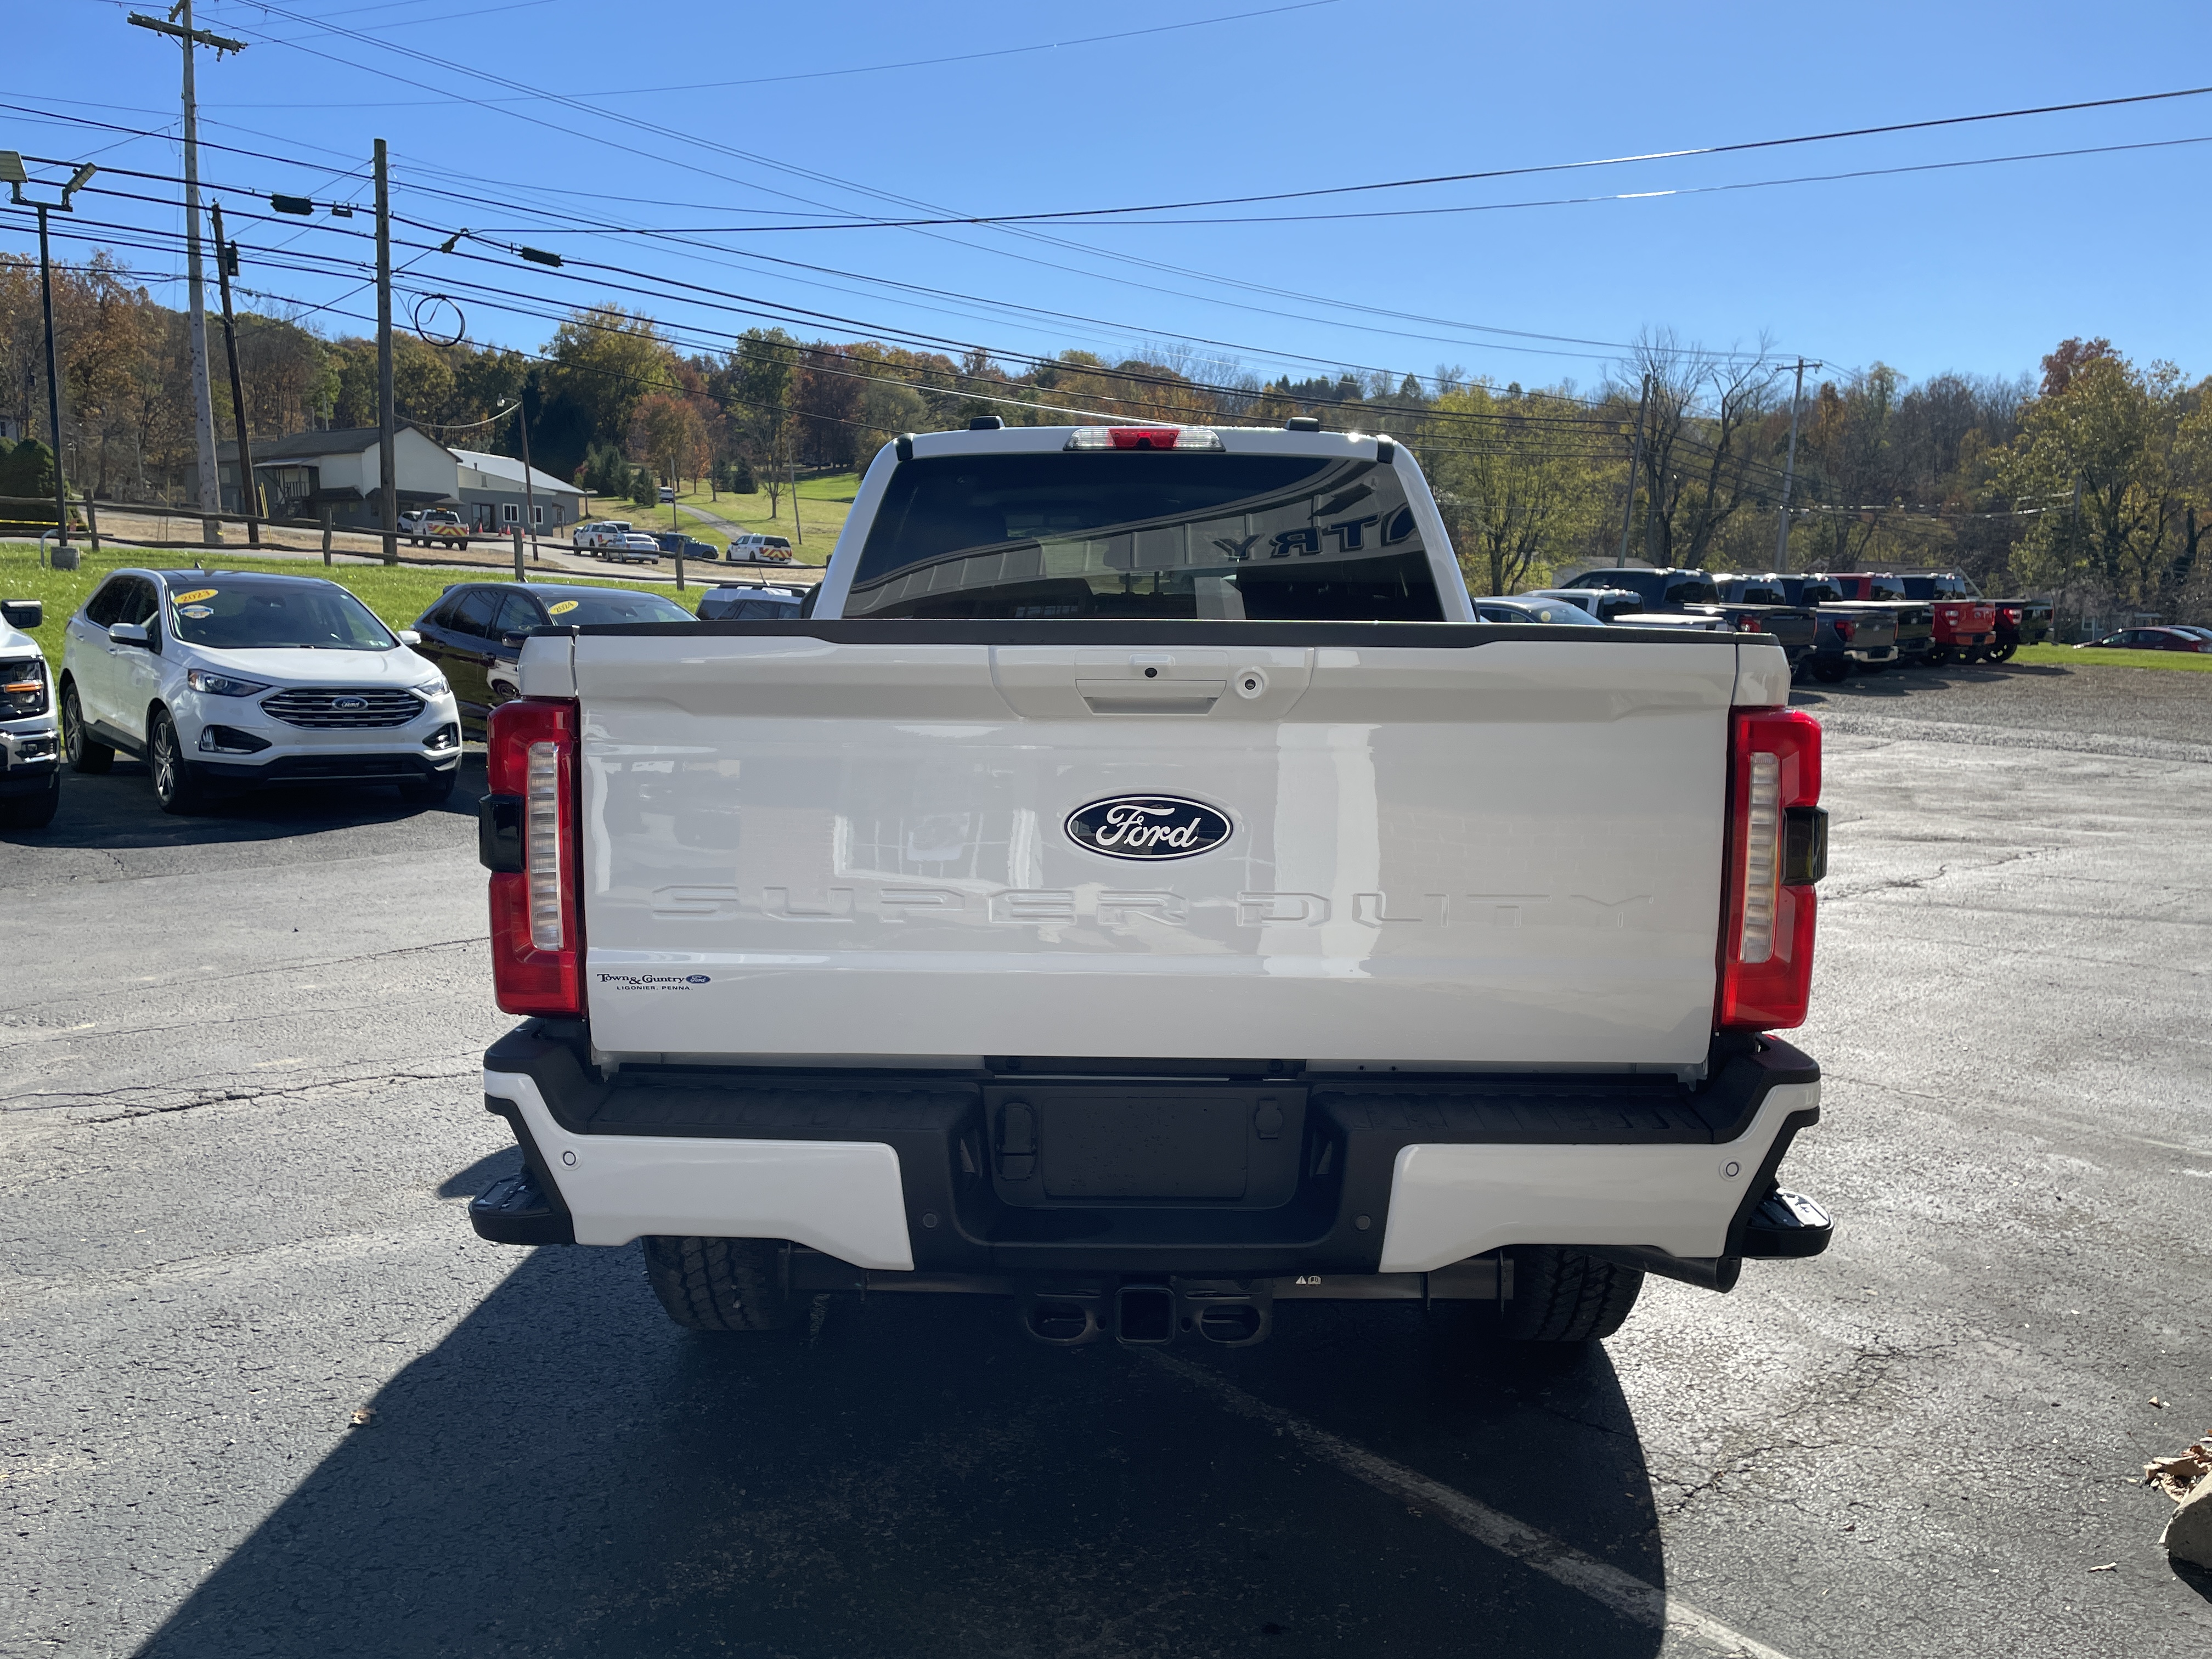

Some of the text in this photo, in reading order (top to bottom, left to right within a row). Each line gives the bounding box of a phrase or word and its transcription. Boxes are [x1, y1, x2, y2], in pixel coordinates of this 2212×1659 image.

[181, 590, 210, 602] 2023
[553, 602, 574, 613] 2024
[1096, 805, 1201, 848] Ford
[651, 884, 1654, 928] SUPER DUTY
